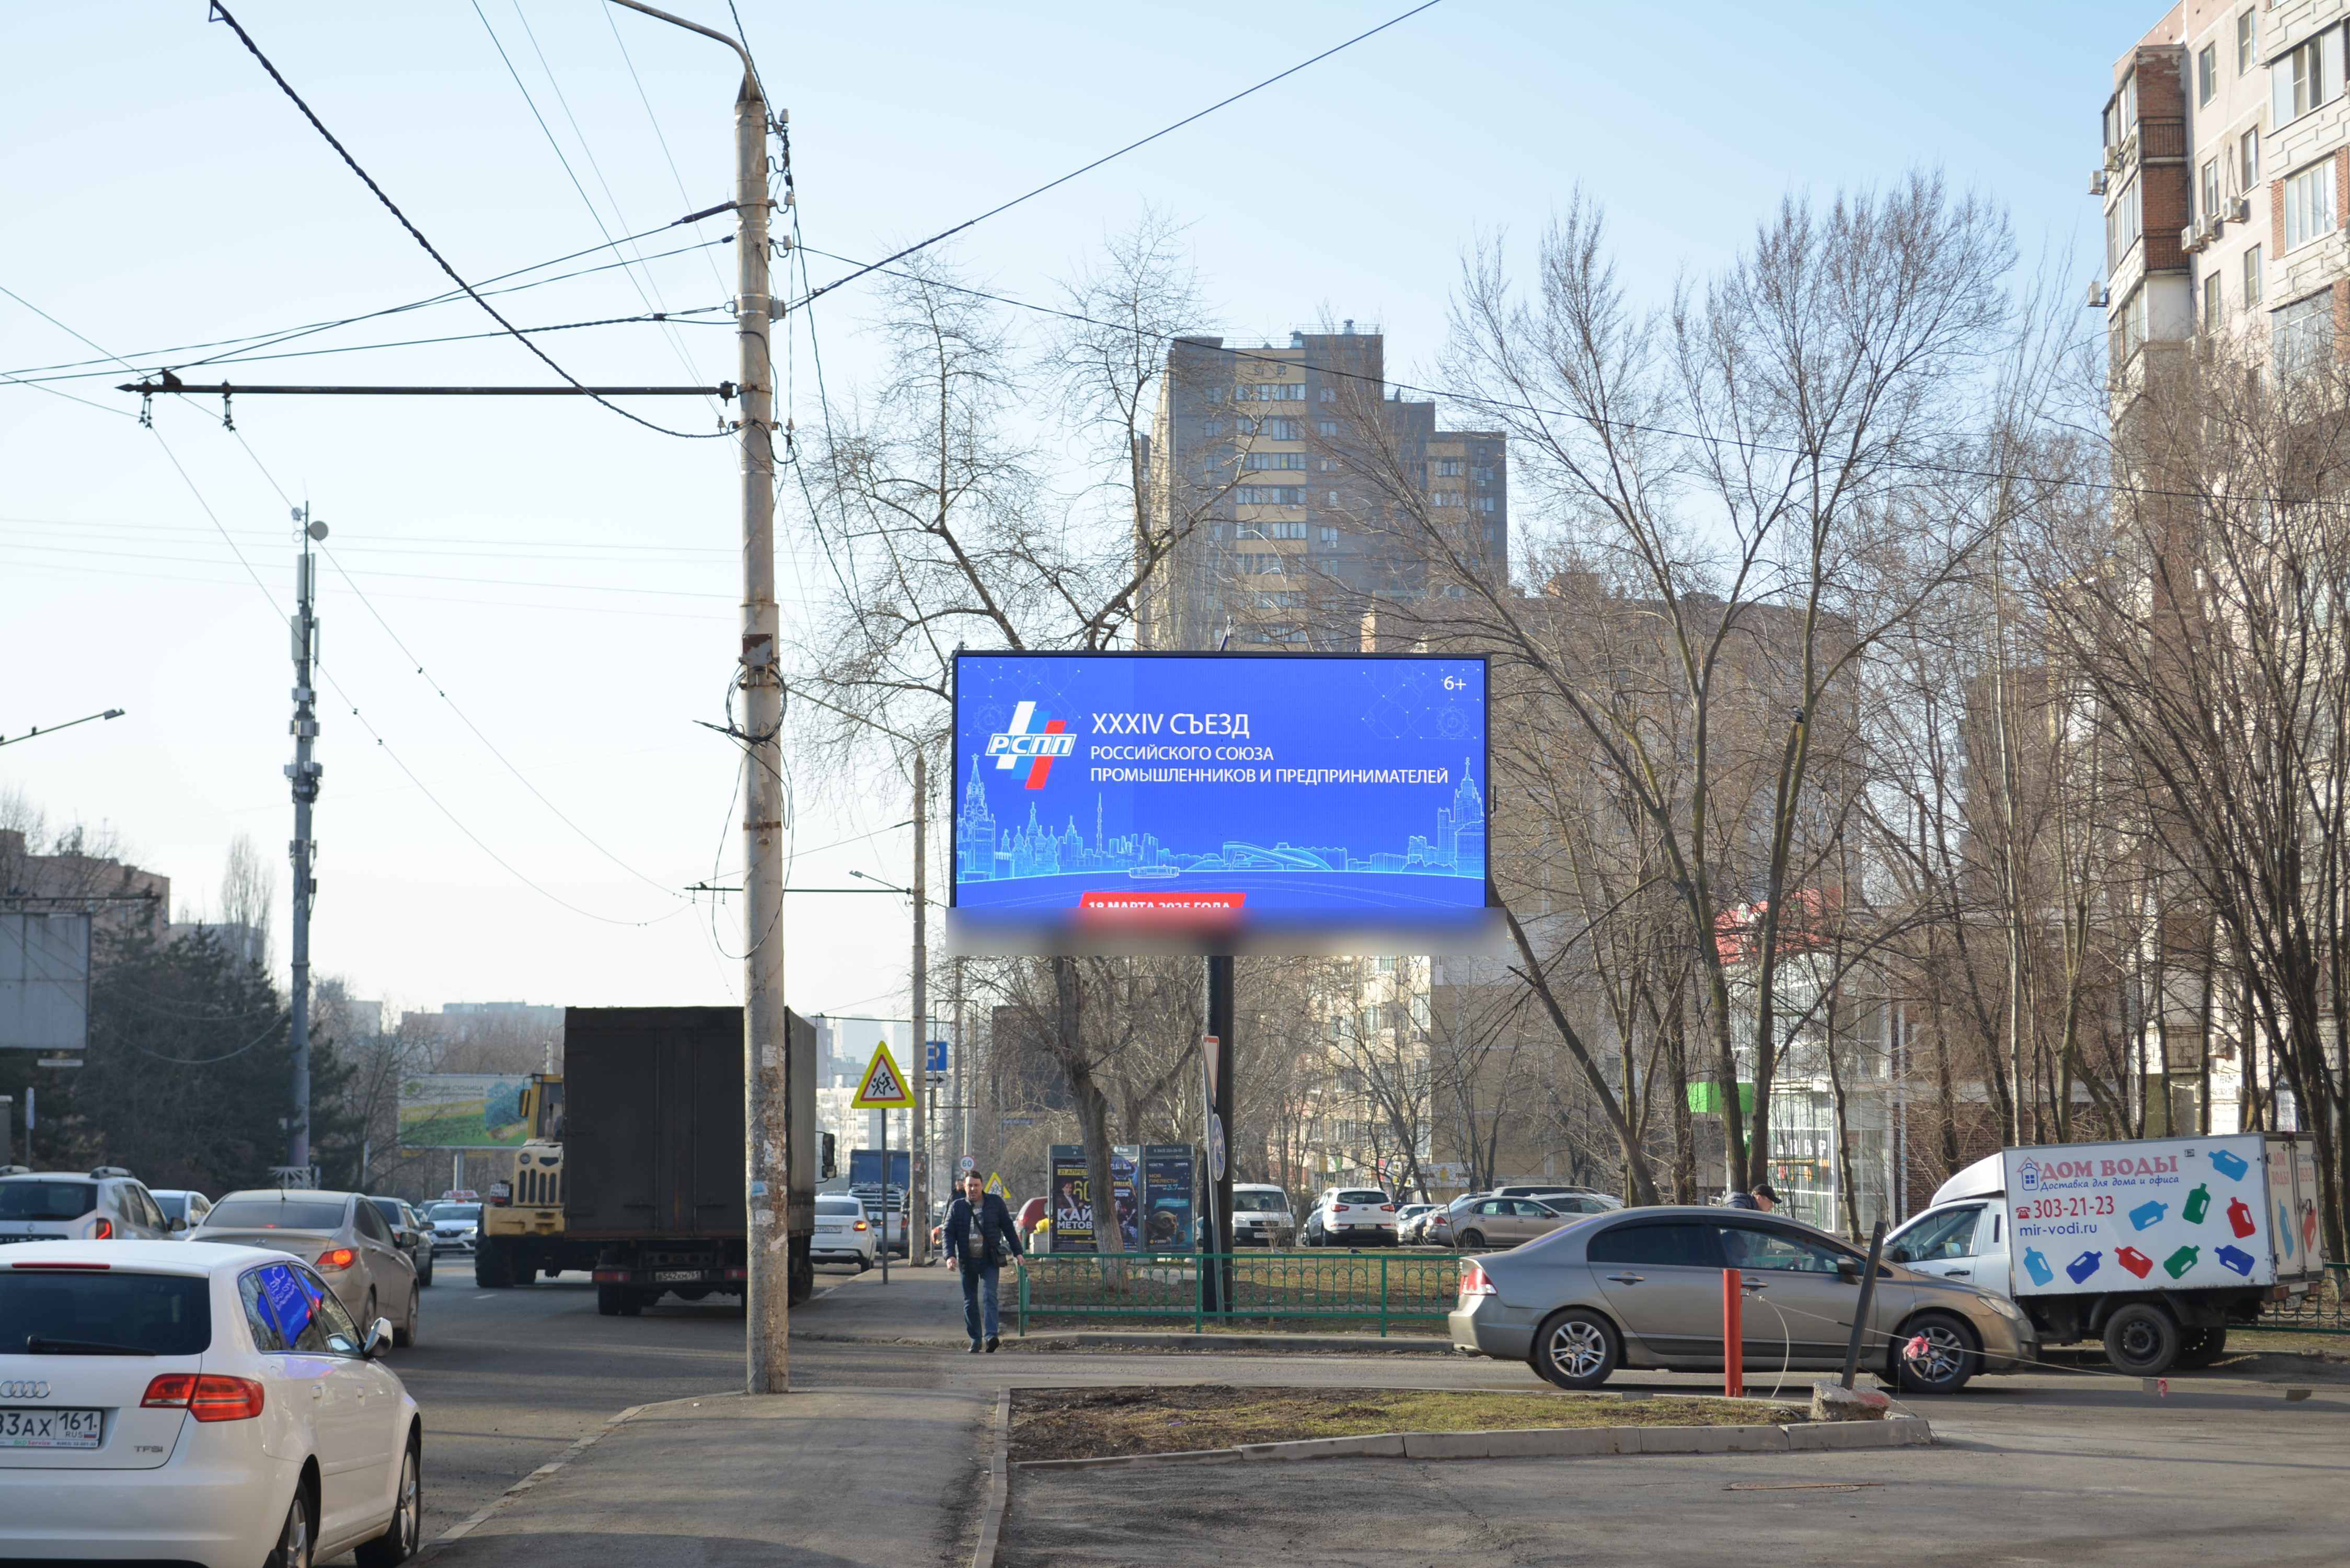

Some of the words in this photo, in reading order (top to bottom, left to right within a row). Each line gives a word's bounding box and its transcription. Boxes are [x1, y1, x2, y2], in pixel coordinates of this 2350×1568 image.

[1444, 675, 1467, 690] 6+
[1092, 713, 1165, 734] XXXIV
[1170, 713, 1250, 739] СЪЕЗД
[989, 735, 1072, 754] РСПП
[1091, 744, 1211, 760] РОССИЙСКОГО
[1215, 746, 1274, 761] СОЮЗА
[1090, 768, 1256, 782] ПРОМЫШЛЕННИКОВ
[1260, 769, 1271, 782] И
[1276, 767, 1448, 786] ПРЕДПРИНИМАТЕЛЕЙ
[2040, 1160, 2093, 1181] ДОМ
[2100, 1155, 2179, 1177] ВОДЫ
[2040, 1179, 2089, 1192] Доставка
[2092, 1178, 2108, 1187] для
[2112, 1177, 2136, 1186] дома
[2149, 1175, 2179, 1186] офиса
[1057, 1205, 1093, 1221] КАЙ
[2033, 1195, 2115, 1219] 303-21-23
[2020, 1222, 2098, 1237] mir-vodi.ru
[59, 1412, 94, 1431] 161
